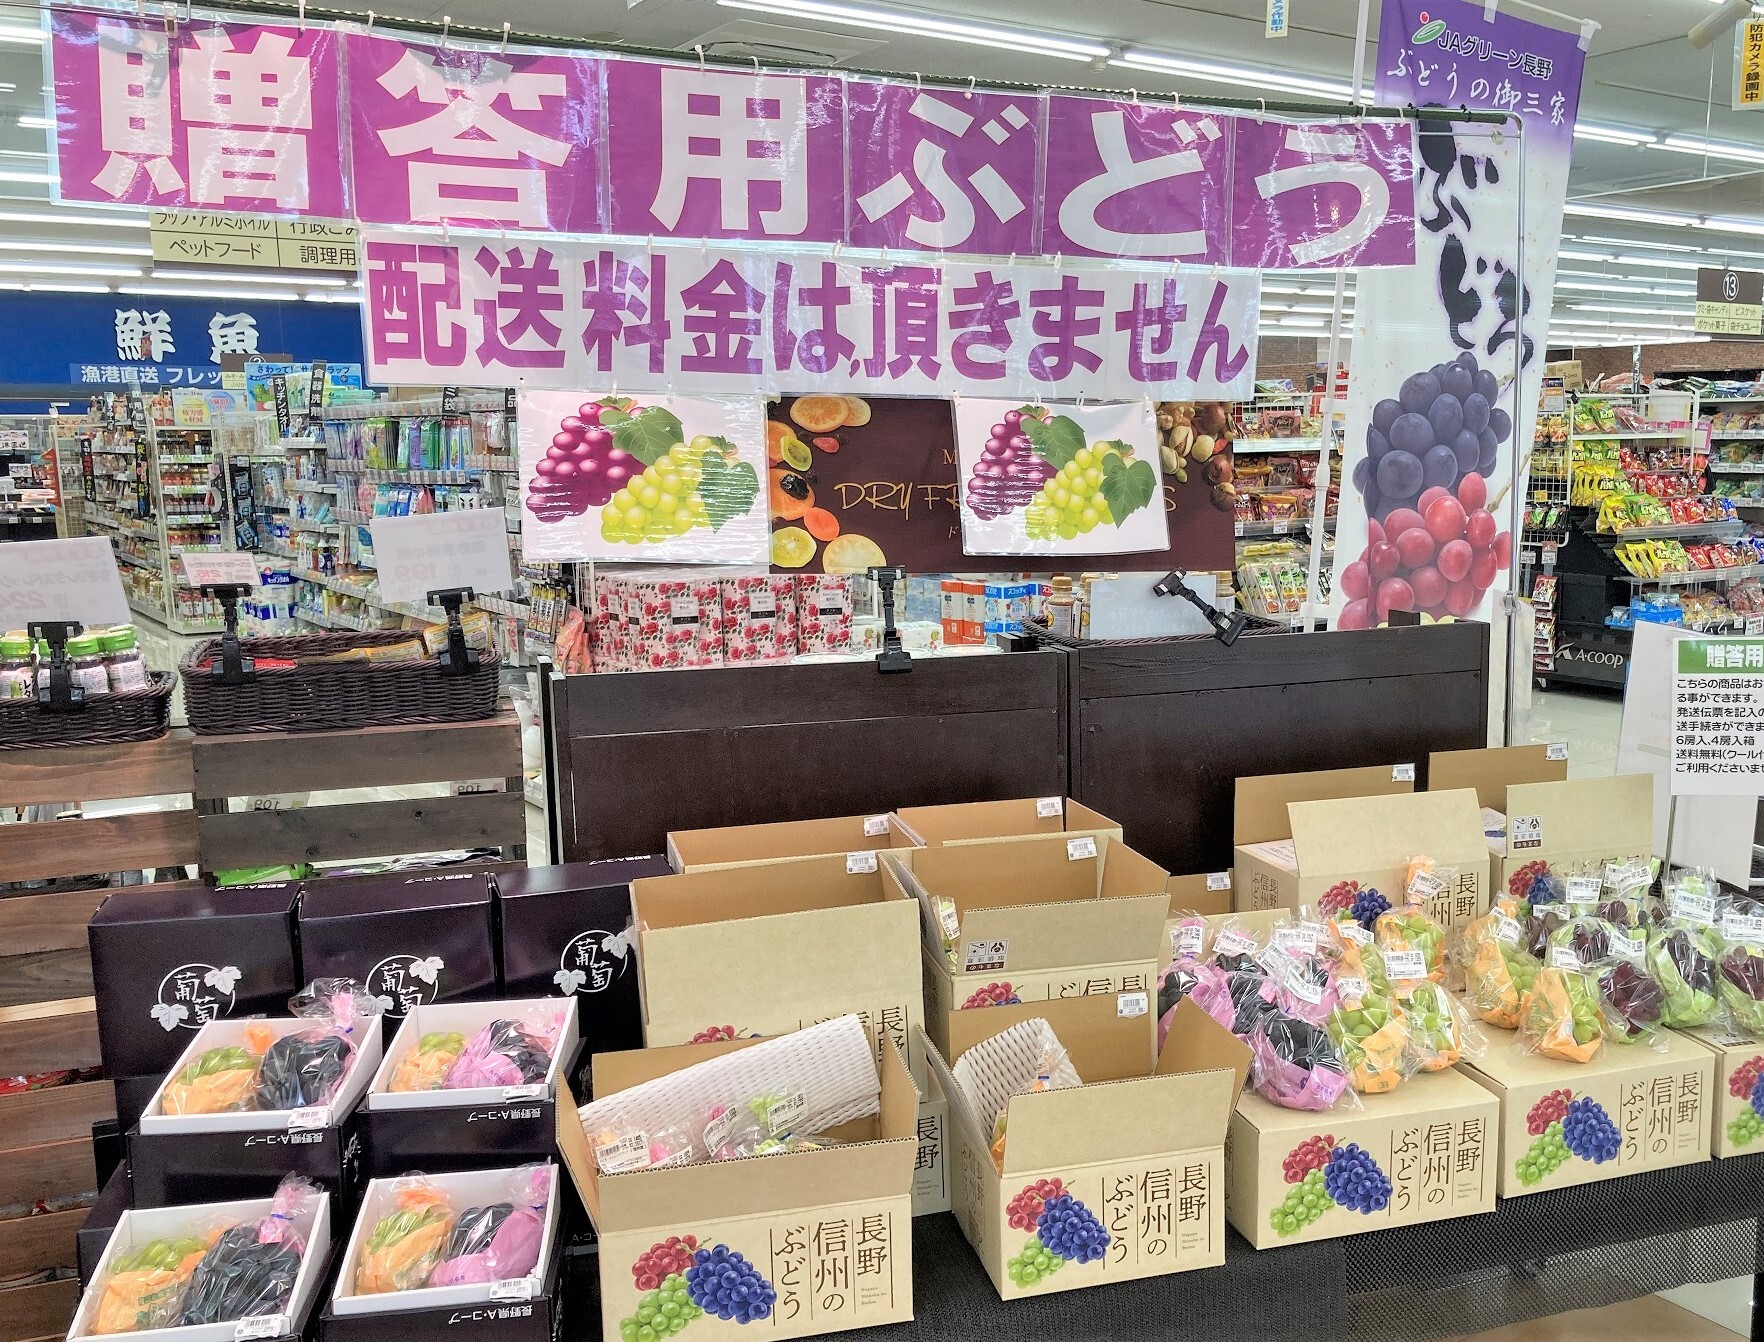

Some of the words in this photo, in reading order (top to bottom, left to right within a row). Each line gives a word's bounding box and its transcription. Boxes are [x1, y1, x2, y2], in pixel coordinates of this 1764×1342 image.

[1437, 31, 1554, 80] JAグリーン長野
[1745, 24, 1763, 102] 防犯カメラ録画中
[1387, 49, 1567, 126] ぶどうの御三家
[90, 24, 1391, 266] 贈答用ぶどう
[170, 239, 262, 260] ペットフード
[1725, 276, 1737, 297] 13
[81, 366, 159, 384] 漁港直送
[1677, 693, 1758, 704] る事ができます。
[1455, 872, 1477, 918] 長野
[379, 965, 419, 1012] 葡萄
[573, 938, 614, 992] 葡萄
[174, 973, 220, 1022] 葡萄
[1623, 1081, 1645, 1161] ぶどう
[1648, 1076, 1675, 1154] 信州の
[1677, 1071, 1700, 1124] 長野
[1393, 1127, 1419, 1211] ぶどう
[1423, 1122, 1453, 1205] 信州の
[1455, 1118, 1482, 1173] 長野
[1106, 1174, 1134, 1264] ぶどう
[1140, 1168, 1173, 1256] 信州の
[1178, 1163, 1207, 1223] 長野
[774, 1226, 807, 1320] ぶどう
[813, 1218, 849, 1312] 信州の
[855, 1213, 888, 1276] 長野
[448, 1304, 534, 1325] 長野県A・コープ
